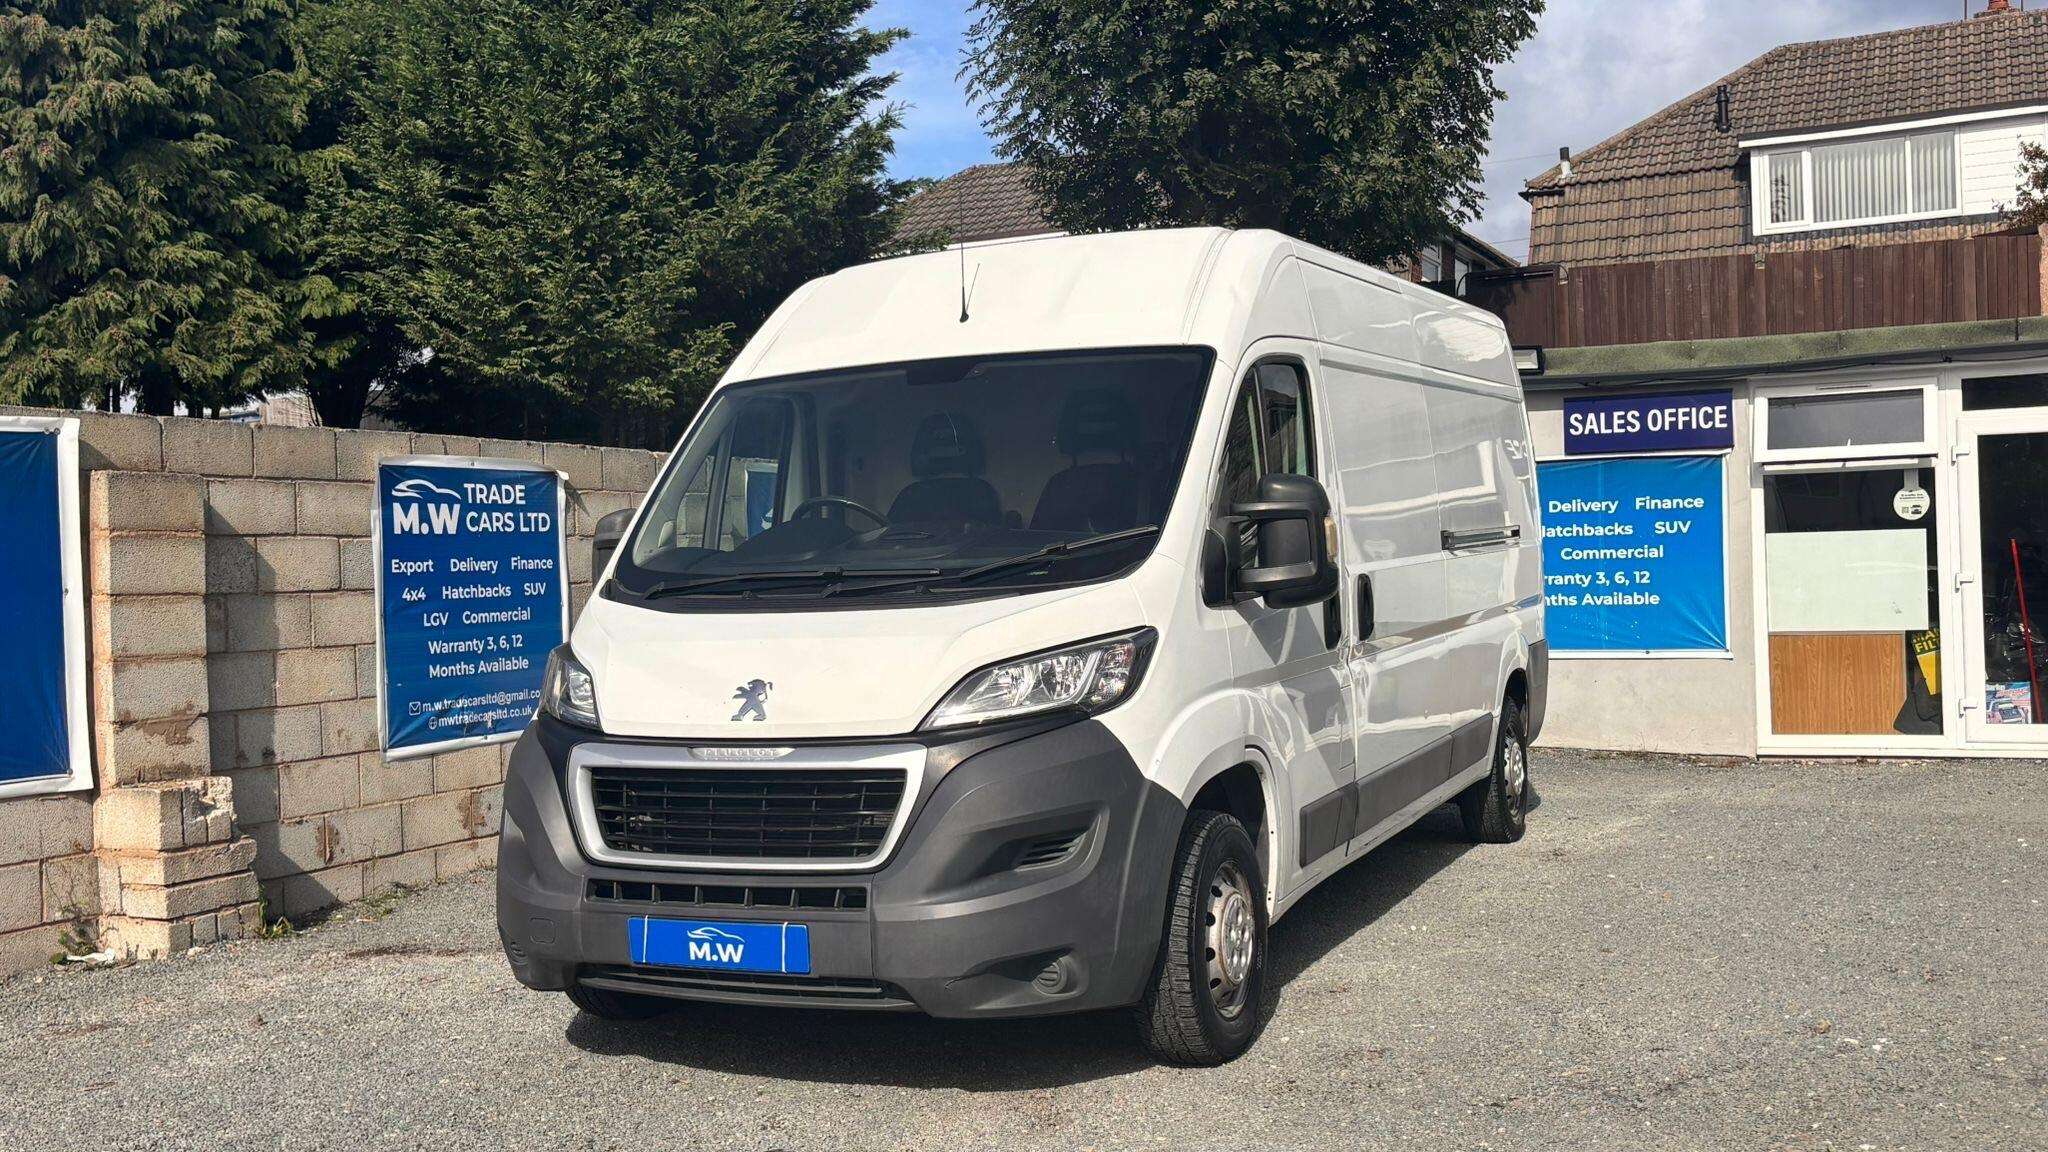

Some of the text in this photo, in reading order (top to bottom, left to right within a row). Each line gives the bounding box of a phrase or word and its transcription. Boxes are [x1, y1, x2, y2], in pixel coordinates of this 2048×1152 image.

[1569, 405, 1728, 436] SALES OFFICE
[464, 483, 526, 505] TRADE
[1548, 496, 1705, 514] Delivery Finance
[392, 502, 461, 535] M.W
[466, 511, 551, 532] CARS LTD
[1654, 520, 1691, 534] SUV
[1560, 545, 1664, 561] Commercial
[391, 556, 553, 575] Export Delivery Finance
[1595, 572, 1610, 586] 3,
[1614, 571, 1630, 586] 6,
[1633, 571, 1651, 584] 12
[401, 582, 546, 601] 4x4 Hatchbacks SUV
[1581, 592, 1661, 606] Available
[423, 607, 531, 627] LGV Commercial
[428, 634, 523, 655] Warranty 3, 6, 12
[429, 656, 529, 679] Months Available
[422, 688, 541, 713] m.w.tradecarsltd@gmail.co
[689, 941, 744, 963] M.W
